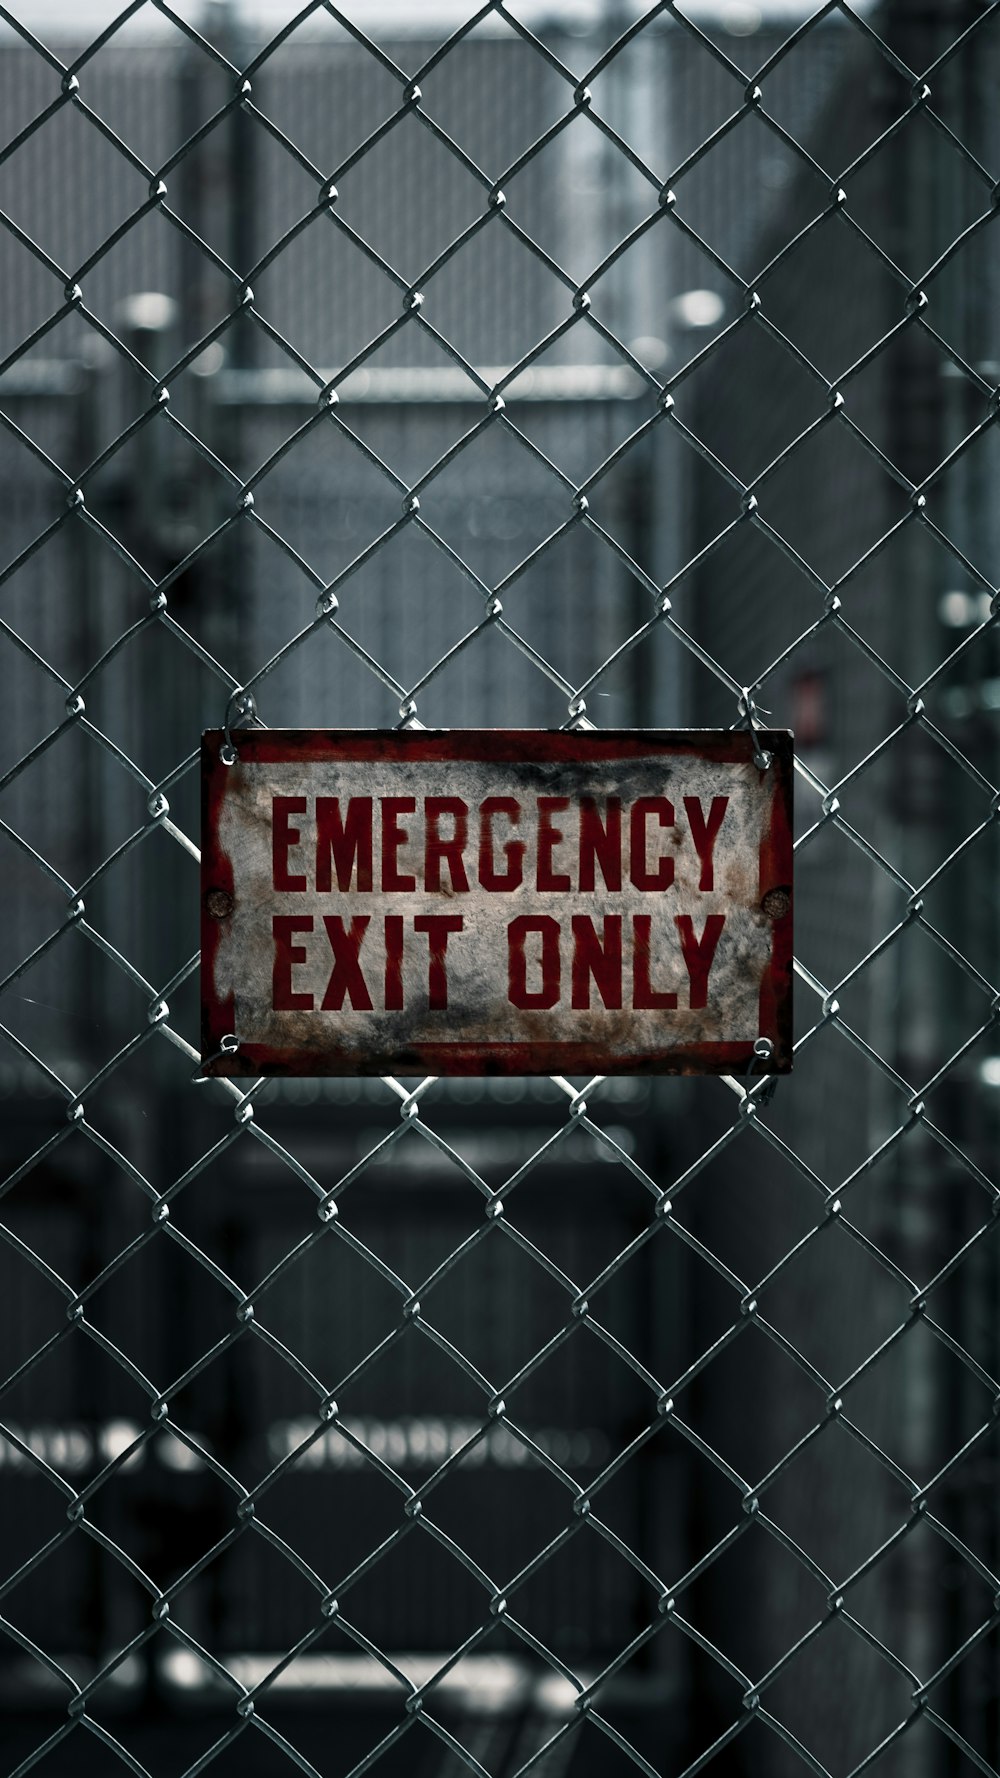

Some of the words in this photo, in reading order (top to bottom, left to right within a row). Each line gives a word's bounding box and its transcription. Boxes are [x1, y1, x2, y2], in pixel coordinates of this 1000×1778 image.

[272, 796, 729, 892] EMERGENCY
[272, 915, 464, 1011] EXIT
[507, 915, 726, 1010] ONLY
